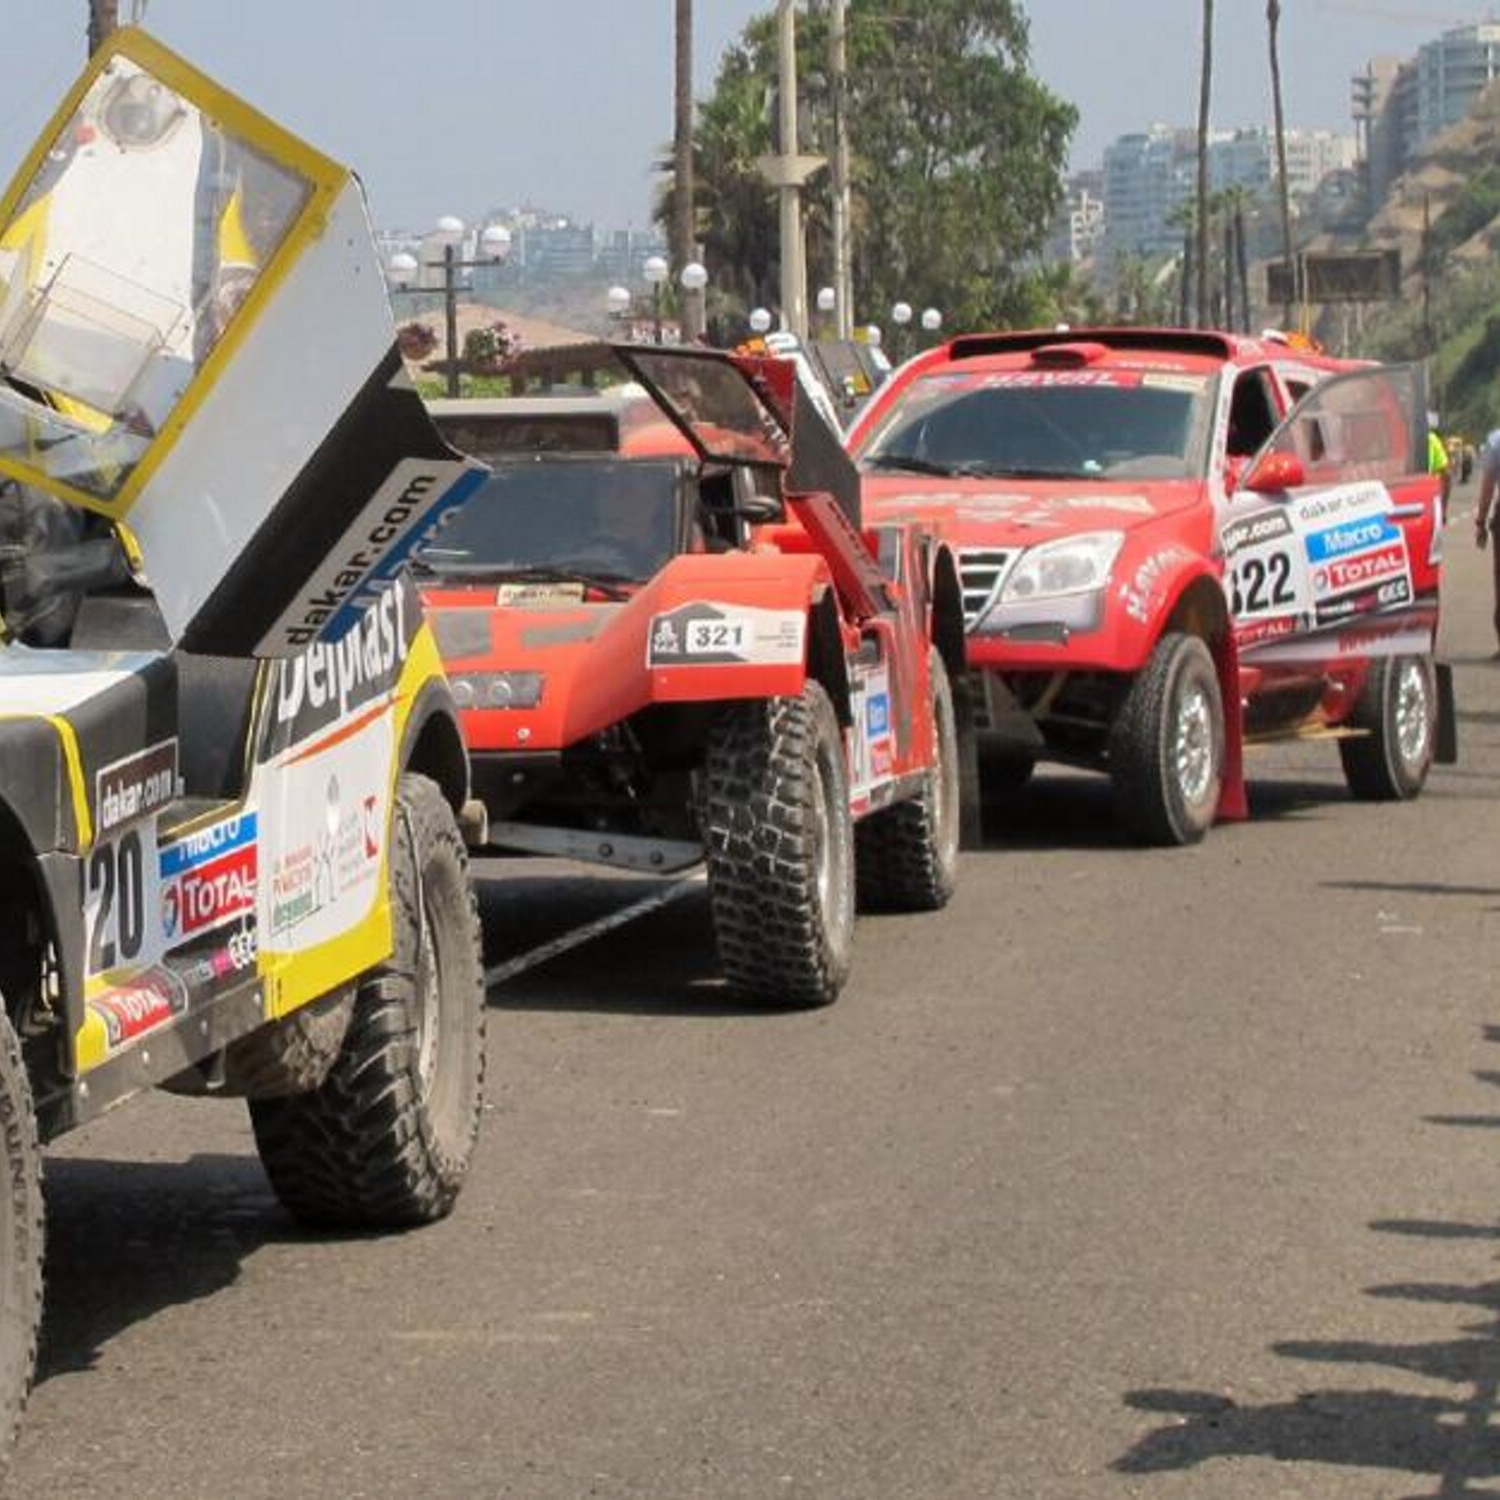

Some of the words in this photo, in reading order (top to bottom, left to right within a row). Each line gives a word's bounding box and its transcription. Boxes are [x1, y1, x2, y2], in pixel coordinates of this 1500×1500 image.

[1323, 520, 1384, 556] Macro
[286, 475, 437, 647] dakar.com
[1332, 551, 1405, 586] TOTAL
[695, 624, 744, 648] 321
[183, 862, 257, 921] TOTAL
